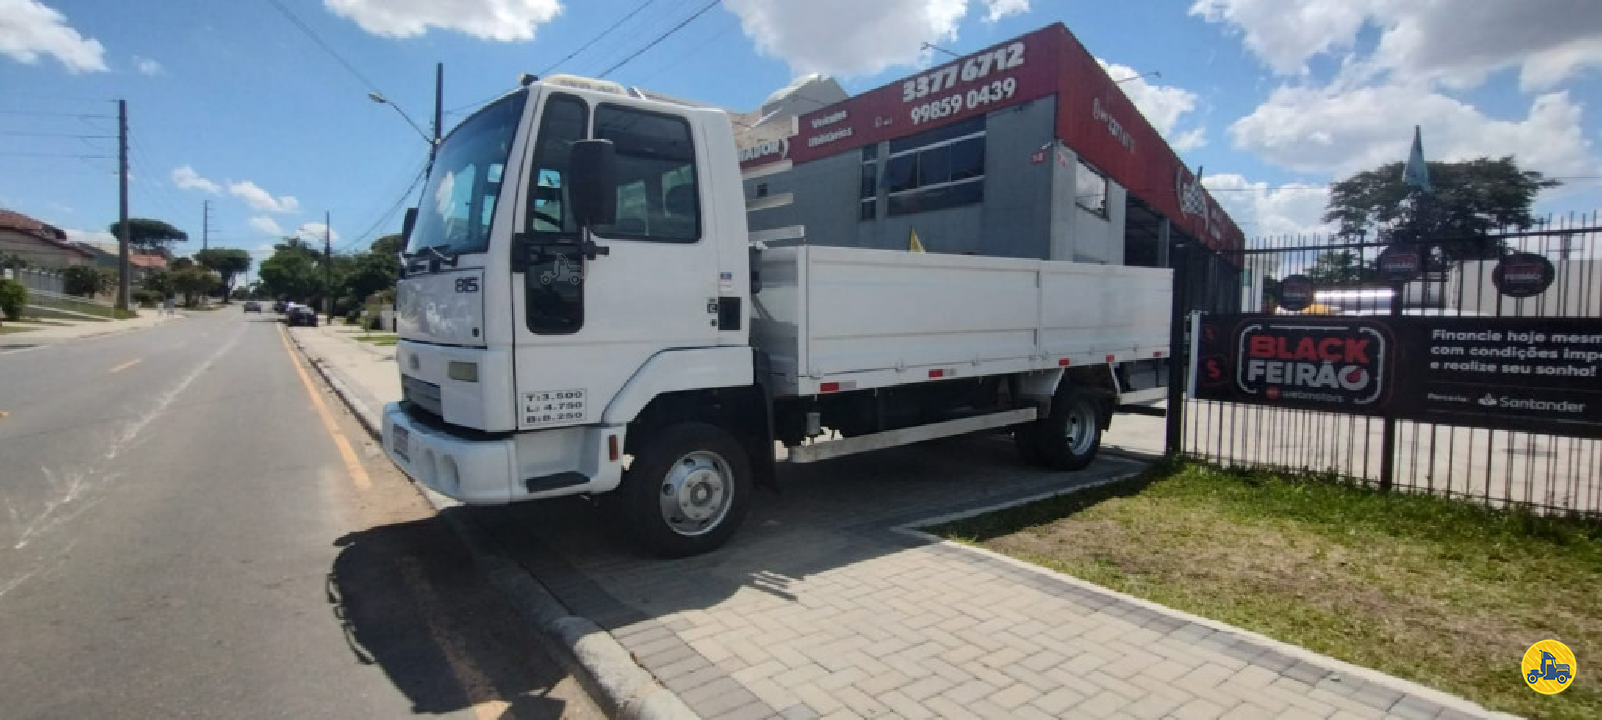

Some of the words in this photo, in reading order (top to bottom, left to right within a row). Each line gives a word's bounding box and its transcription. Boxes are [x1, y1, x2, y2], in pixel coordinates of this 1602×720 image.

[902, 64, 959, 103] 3377
[961, 42, 1026, 82] 6712
[910, 94, 963, 125] 99859
[966, 77, 1017, 109] 0439
[1432, 329, 1502, 341] Financie
[1507, 330, 1546, 344] hoje
[1249, 335, 1370, 364] BLACK
[1430, 346, 1465, 355] com
[1469, 346, 1559, 361] condições
[1247, 360, 1369, 391] FEIRÃO
[1430, 362, 1439, 370] e
[1443, 360, 1497, 372] realize
[1501, 365, 1531, 374] seu
[1535, 365, 1597, 377] sonho!
[1500, 395, 1586, 413] Santander
